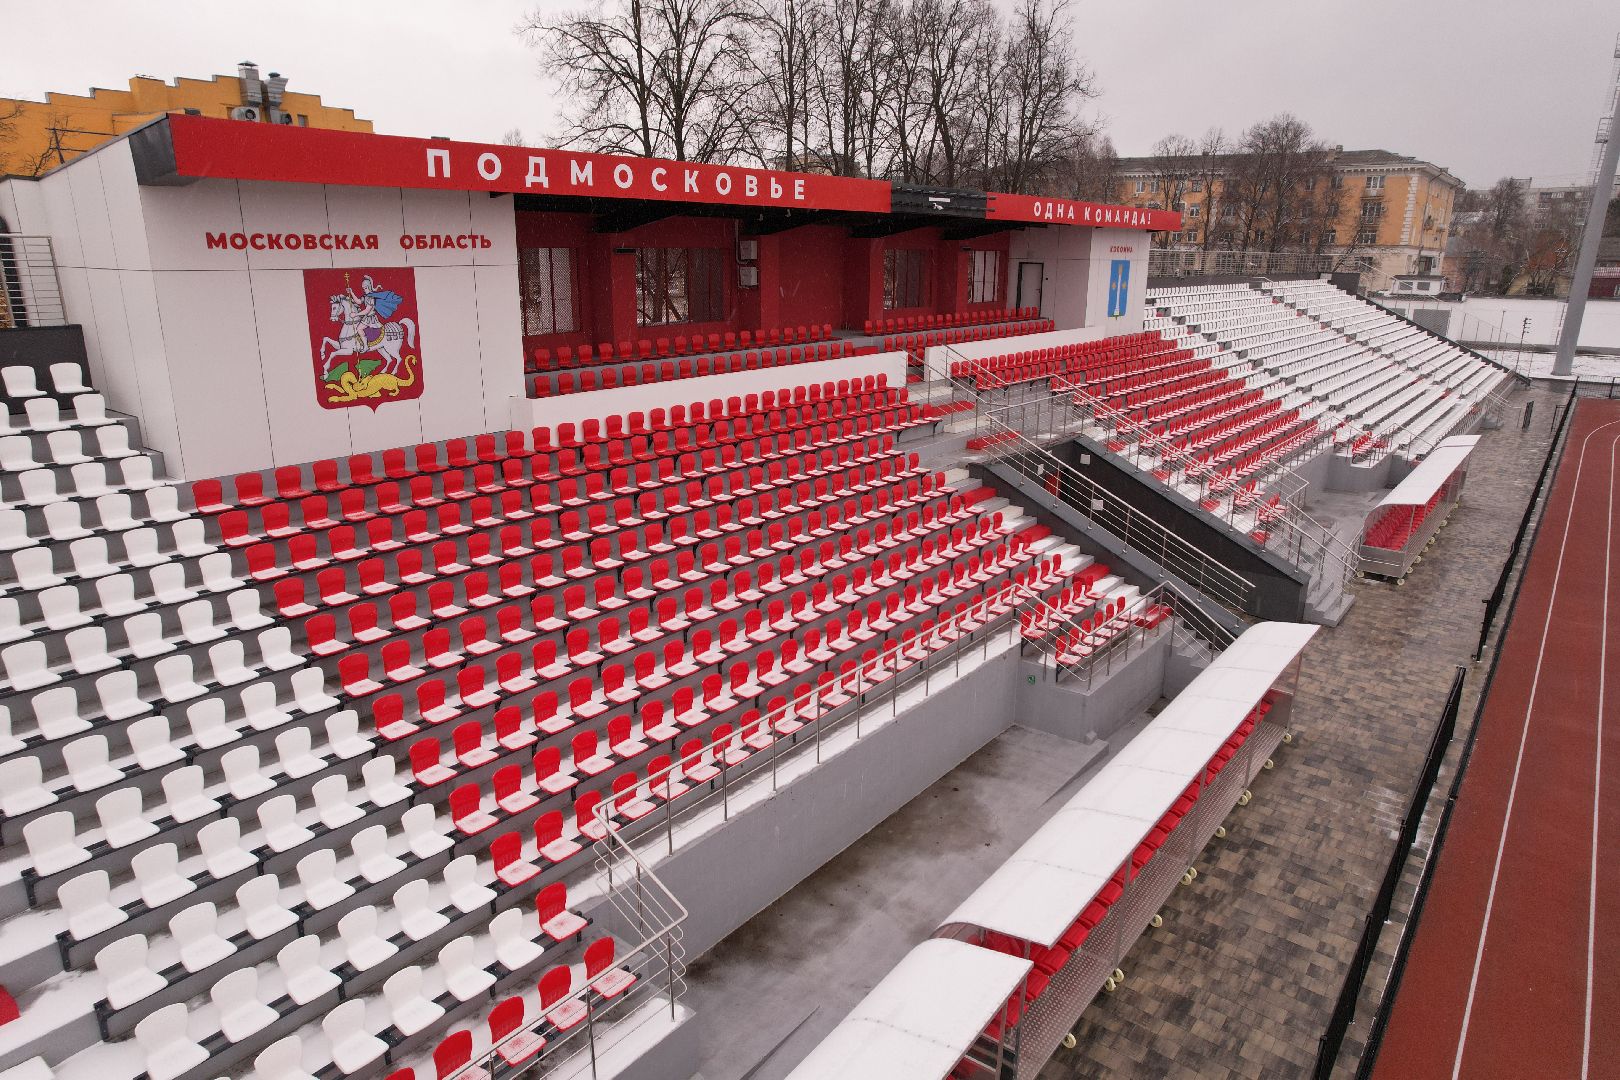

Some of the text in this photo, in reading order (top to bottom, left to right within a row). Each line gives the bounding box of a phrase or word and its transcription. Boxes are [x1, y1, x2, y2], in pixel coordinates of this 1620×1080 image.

[426, 148, 805, 200] ПОДМОСКОВЬЕ
[1033, 201, 1151, 225] ОДНА КОМАНДА!
[205, 231, 492, 250] МОСКОВСКАЯ ОБЛАСТЬ
